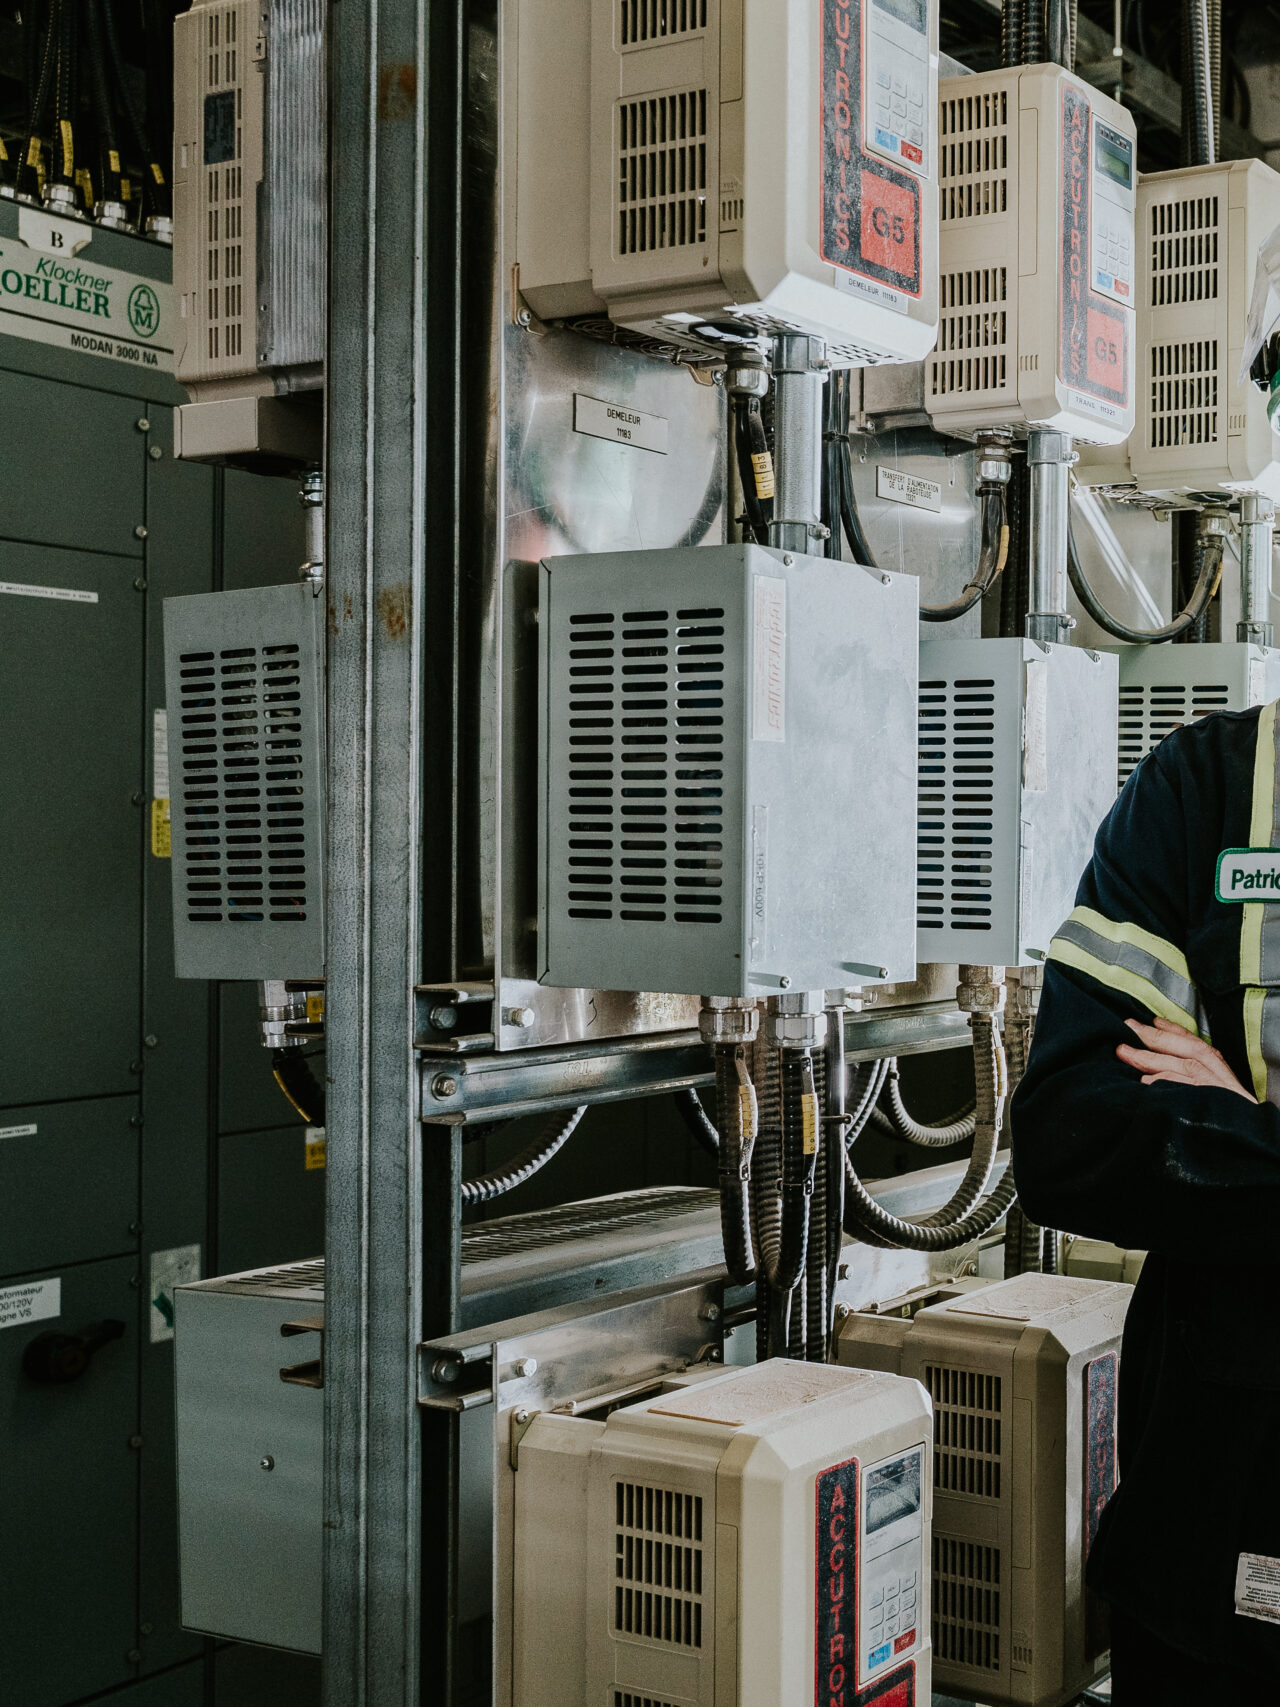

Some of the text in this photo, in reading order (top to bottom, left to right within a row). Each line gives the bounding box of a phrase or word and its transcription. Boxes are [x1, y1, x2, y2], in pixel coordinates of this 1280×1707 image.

[51, 231, 64, 248] B
[871, 206, 905, 244] G5
[1070, 105, 1084, 376] ACCUTRONICS
[0, 260, 111, 319] OELLER
[36, 257, 113, 292] Klockner
[848, 278, 879, 296] DEMELEUR
[71, 334, 158, 365] MODAN 3000 NA
[1094, 336, 1117, 366] G5
[607, 408, 641, 425] DEMELEUR
[616, 428, 632, 440] 11183
